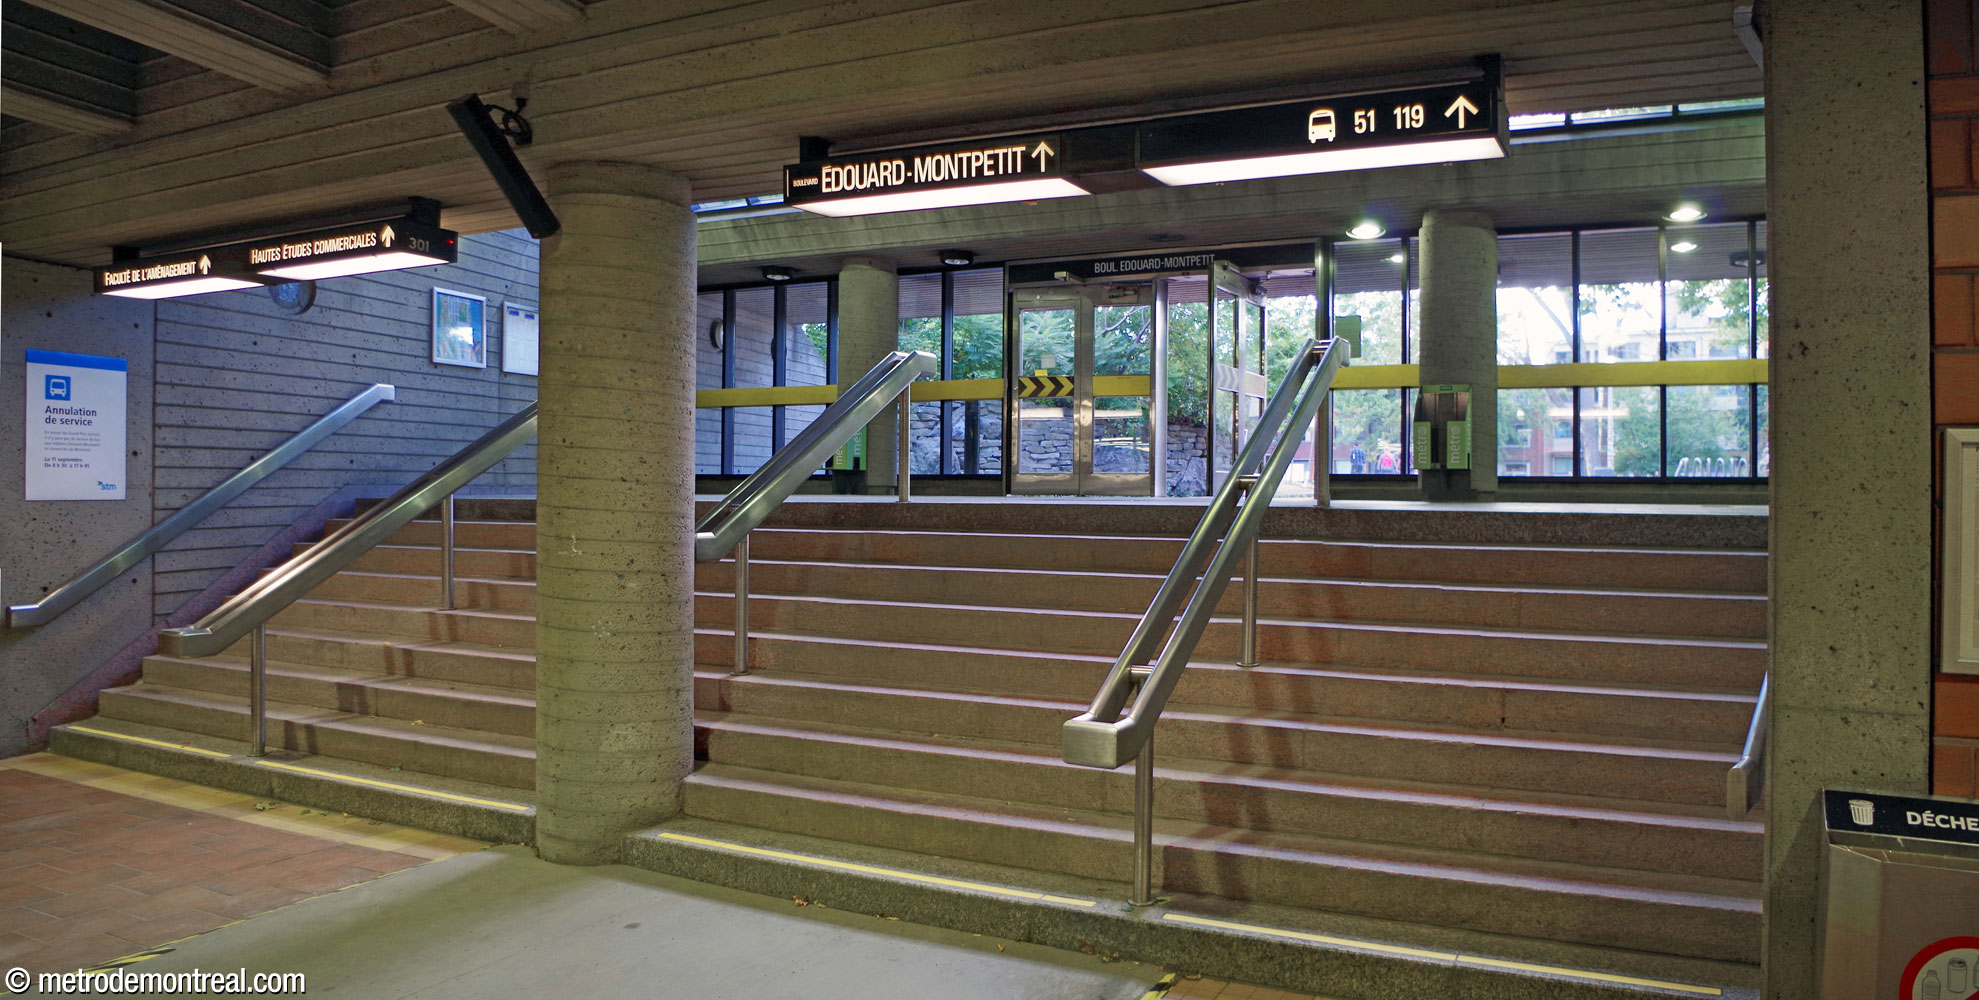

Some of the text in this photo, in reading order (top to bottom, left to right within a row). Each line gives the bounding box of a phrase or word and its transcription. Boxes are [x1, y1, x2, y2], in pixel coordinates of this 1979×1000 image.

[1354, 105, 1424, 134] 51 119
[792, 146, 1026, 193] BOULEVARD ÉDOUARD-MONTPETIT
[251, 232, 377, 264] HAUTES ÉTUDES COMMERCIALES
[409, 237, 430, 253] 301
[1120, 254, 1215, 272] EDOUARD-MONTPETIT
[105, 261, 197, 286] FACULTÉ DE L'AMÉNAGEMENT
[44, 405, 97, 417] Annulation
[45, 415, 93, 426] de service
[101, 483, 117, 491] stm
